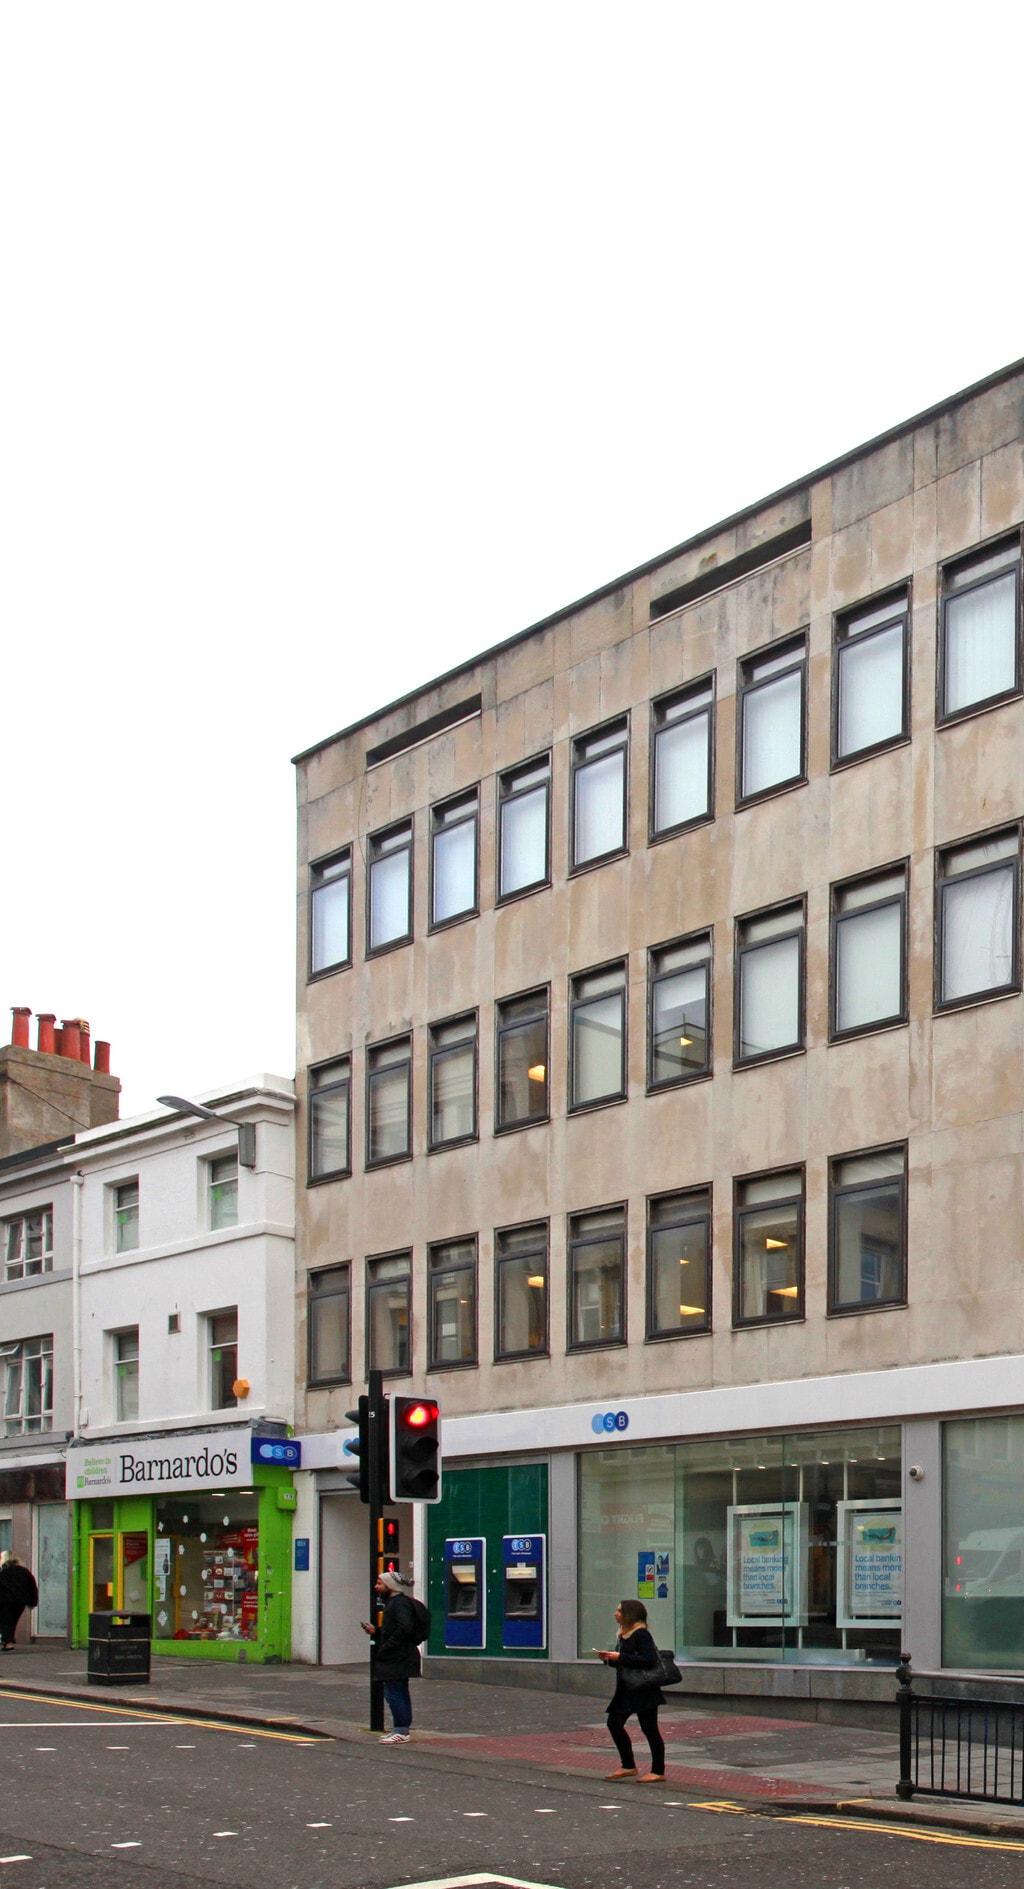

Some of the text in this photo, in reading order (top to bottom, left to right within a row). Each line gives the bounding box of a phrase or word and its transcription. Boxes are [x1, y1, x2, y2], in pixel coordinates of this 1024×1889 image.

[593, 1413, 627, 1431] TSB
[262, 1446, 295, 1458] SB
[119, 1447, 238, 1483] Barnardo's
[84, 1467, 108, 1475] children
[84, 1476, 112, 1486] Barnardo's
[454, 1543, 471, 1552] TSB
[513, 1540, 530, 1550] TSB
[743, 1555, 789, 1565] Local banking
[855, 1554, 902, 1562] Local bankin
[759, 1573, 775, 1581] local
[855, 1572, 891, 1581] than local
[743, 1582, 776, 1590] branches.
[855, 1582, 892, 1590] branches.
